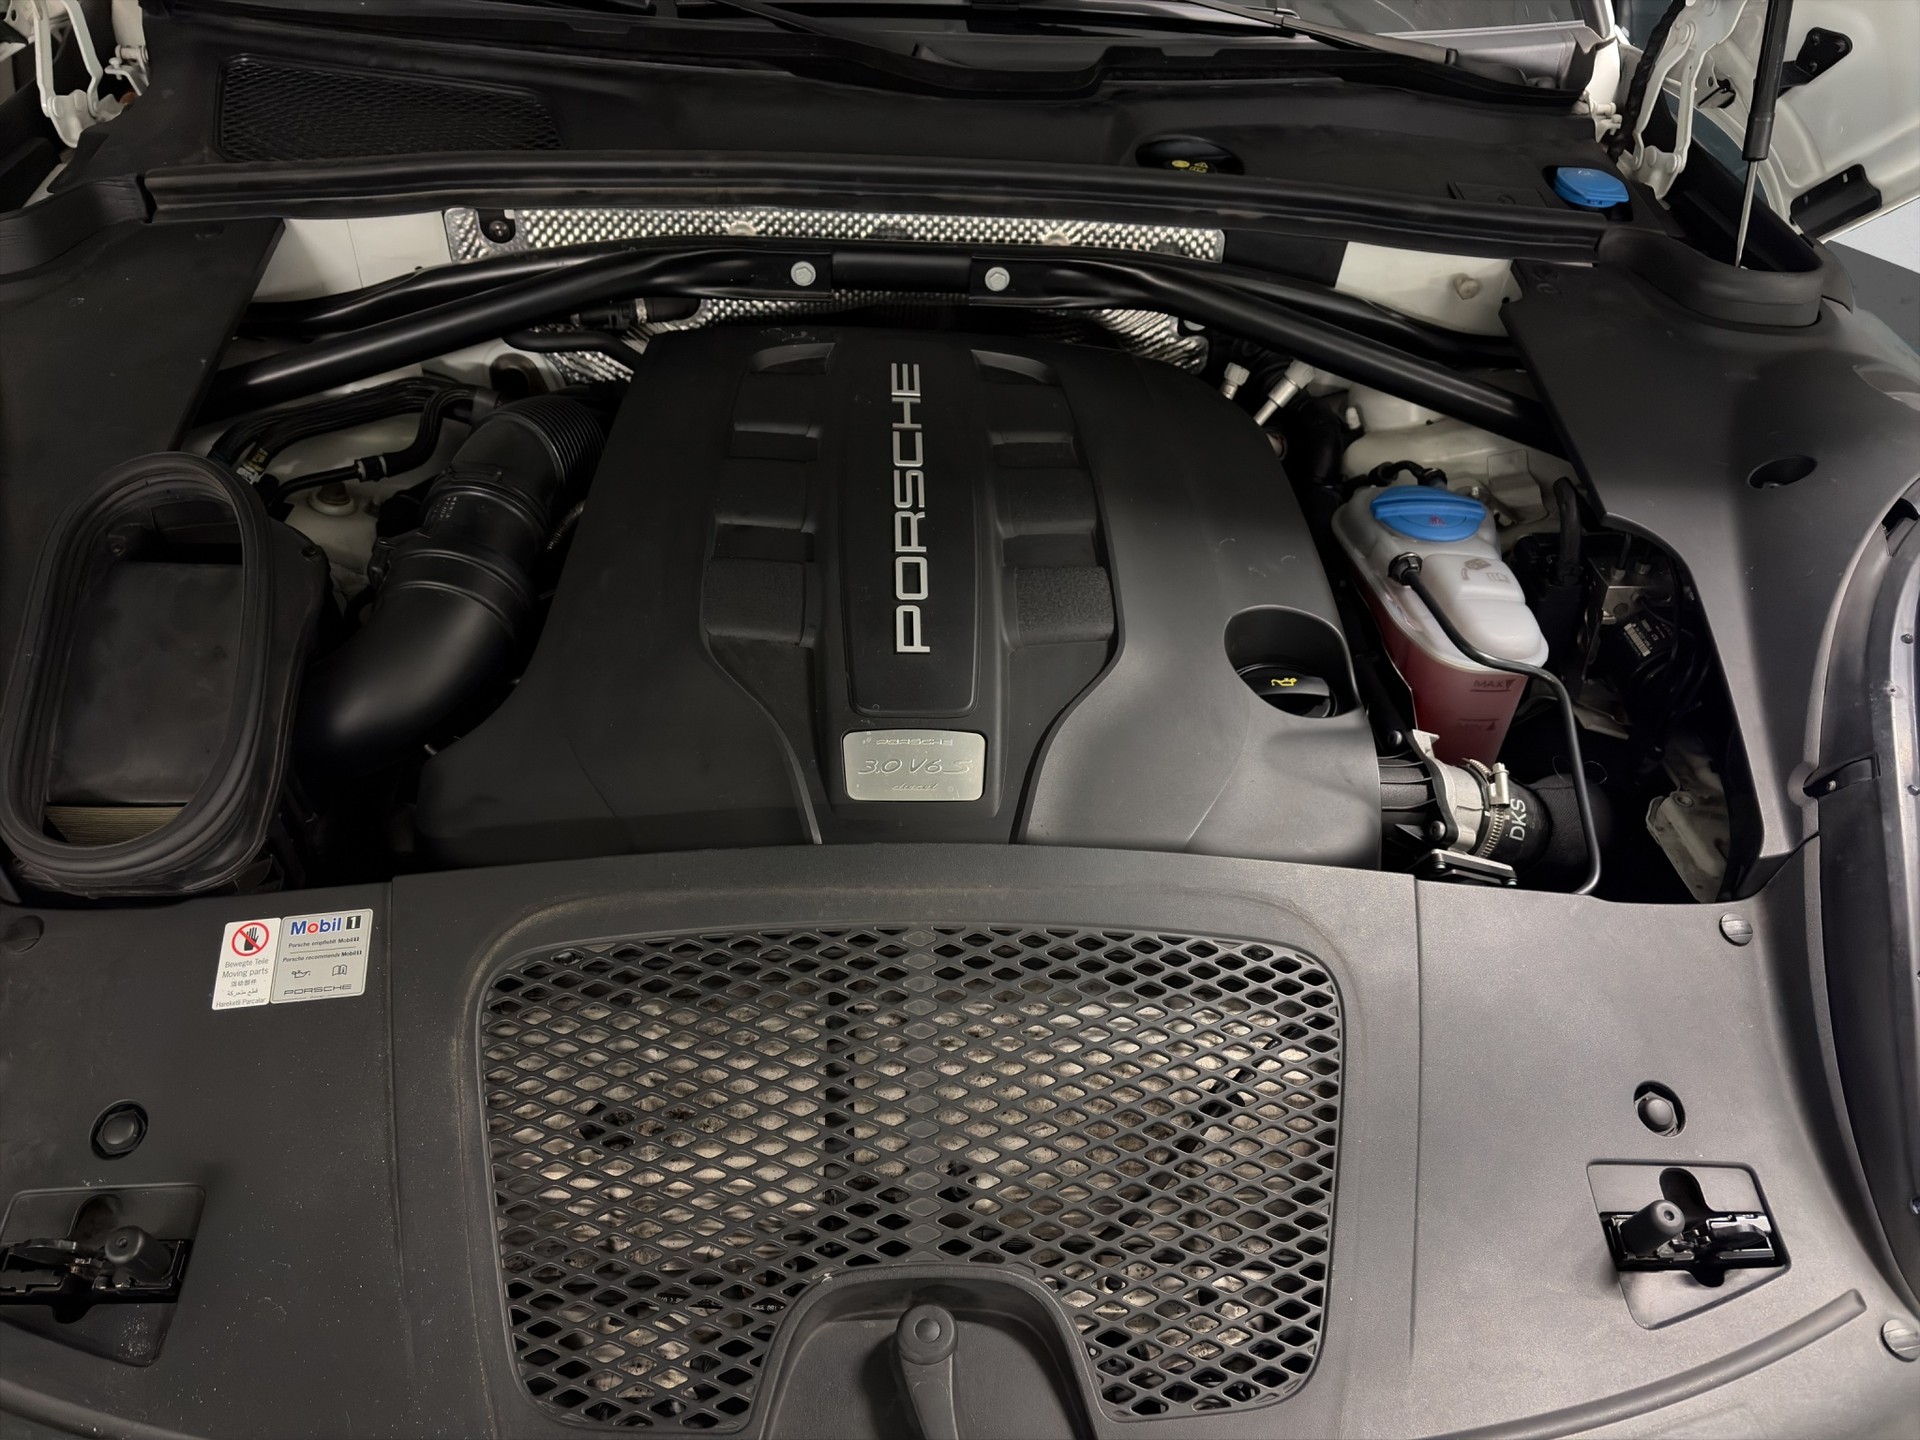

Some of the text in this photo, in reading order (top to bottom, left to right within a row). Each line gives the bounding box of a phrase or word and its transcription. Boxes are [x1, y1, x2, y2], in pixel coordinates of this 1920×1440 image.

[891, 362, 930, 653] PORSCHE
[1473, 679, 1504, 689] MAX
[858, 759, 973, 775] 3.0 V6 S
[1509, 798, 1527, 841] DKS
[290, 917, 342, 935] Mobil
[224, 957, 269, 969] Bewegte Teile
[282, 955, 305, 963] Porsche
[305, 952, 341, 960] recommends
[222, 967, 269, 979] Moving parts
[283, 983, 352, 996] PORSCHE
